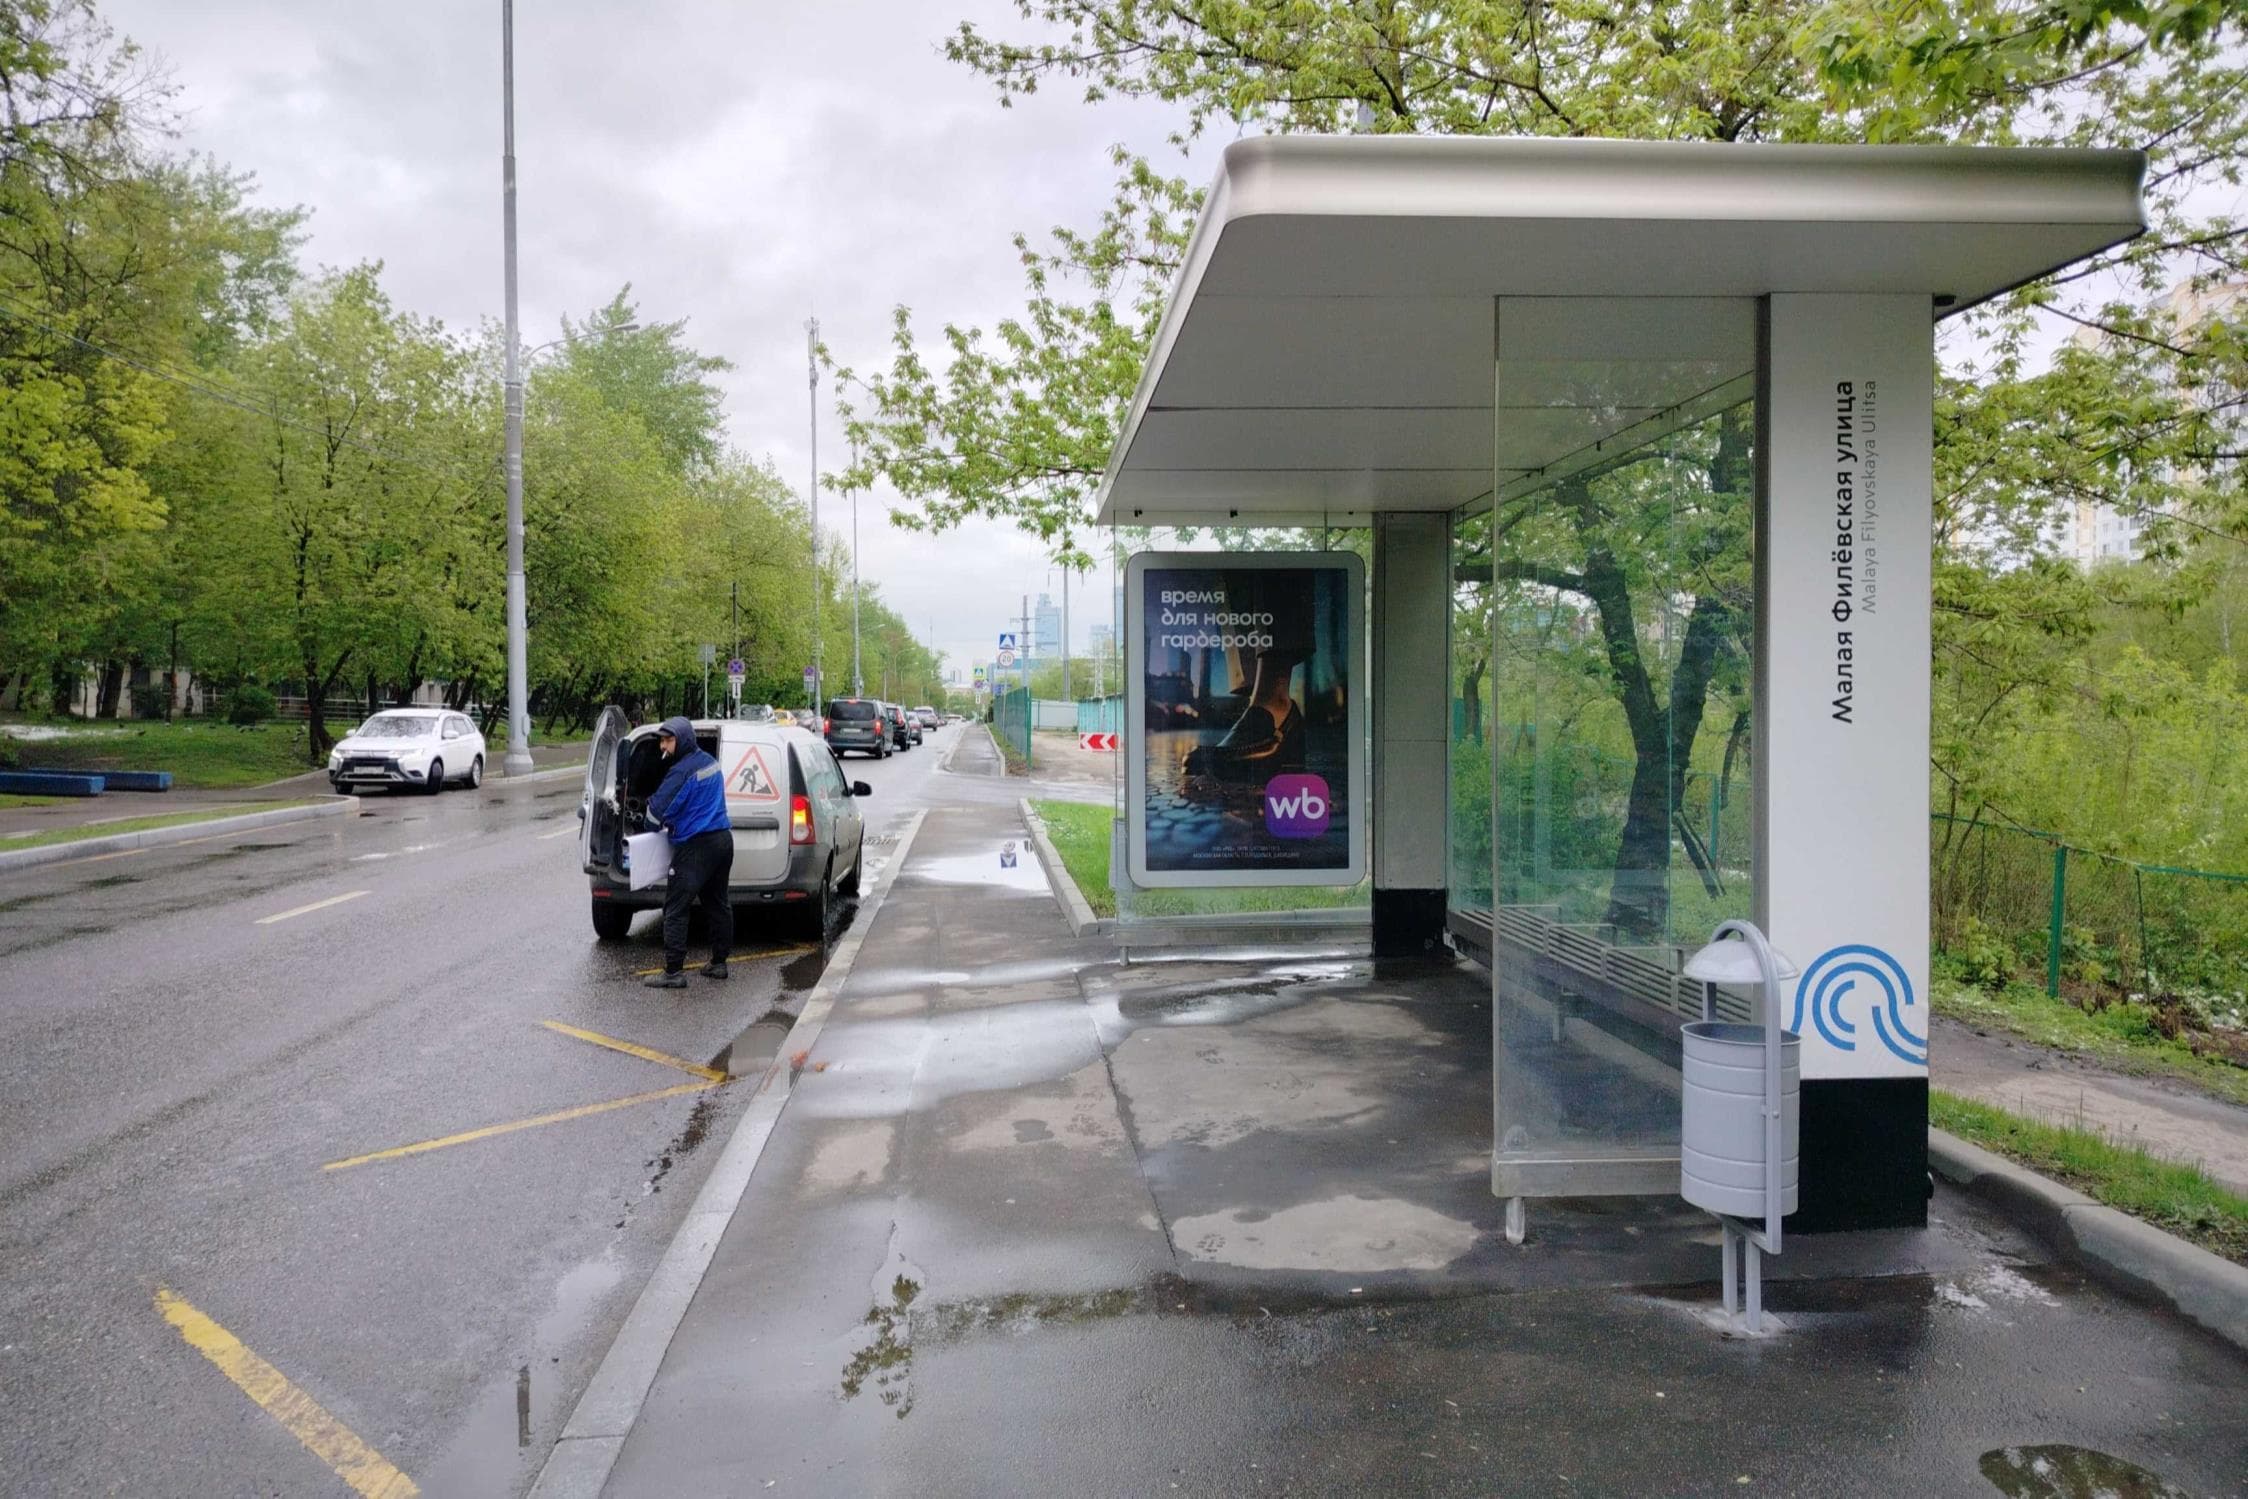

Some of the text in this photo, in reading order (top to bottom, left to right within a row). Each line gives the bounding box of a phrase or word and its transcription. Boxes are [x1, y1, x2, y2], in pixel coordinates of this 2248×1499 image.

[1860, 380, 1878, 614] Malaya Filyovskaya Ulitsa
[1831, 380, 1857, 725] Малая Филёвская улица
[1161, 590, 1225, 606] время
[1161, 609, 1273, 626] для нового
[1161, 630, 1273, 651] гардероба
[1269, 788, 1325, 819] wb
